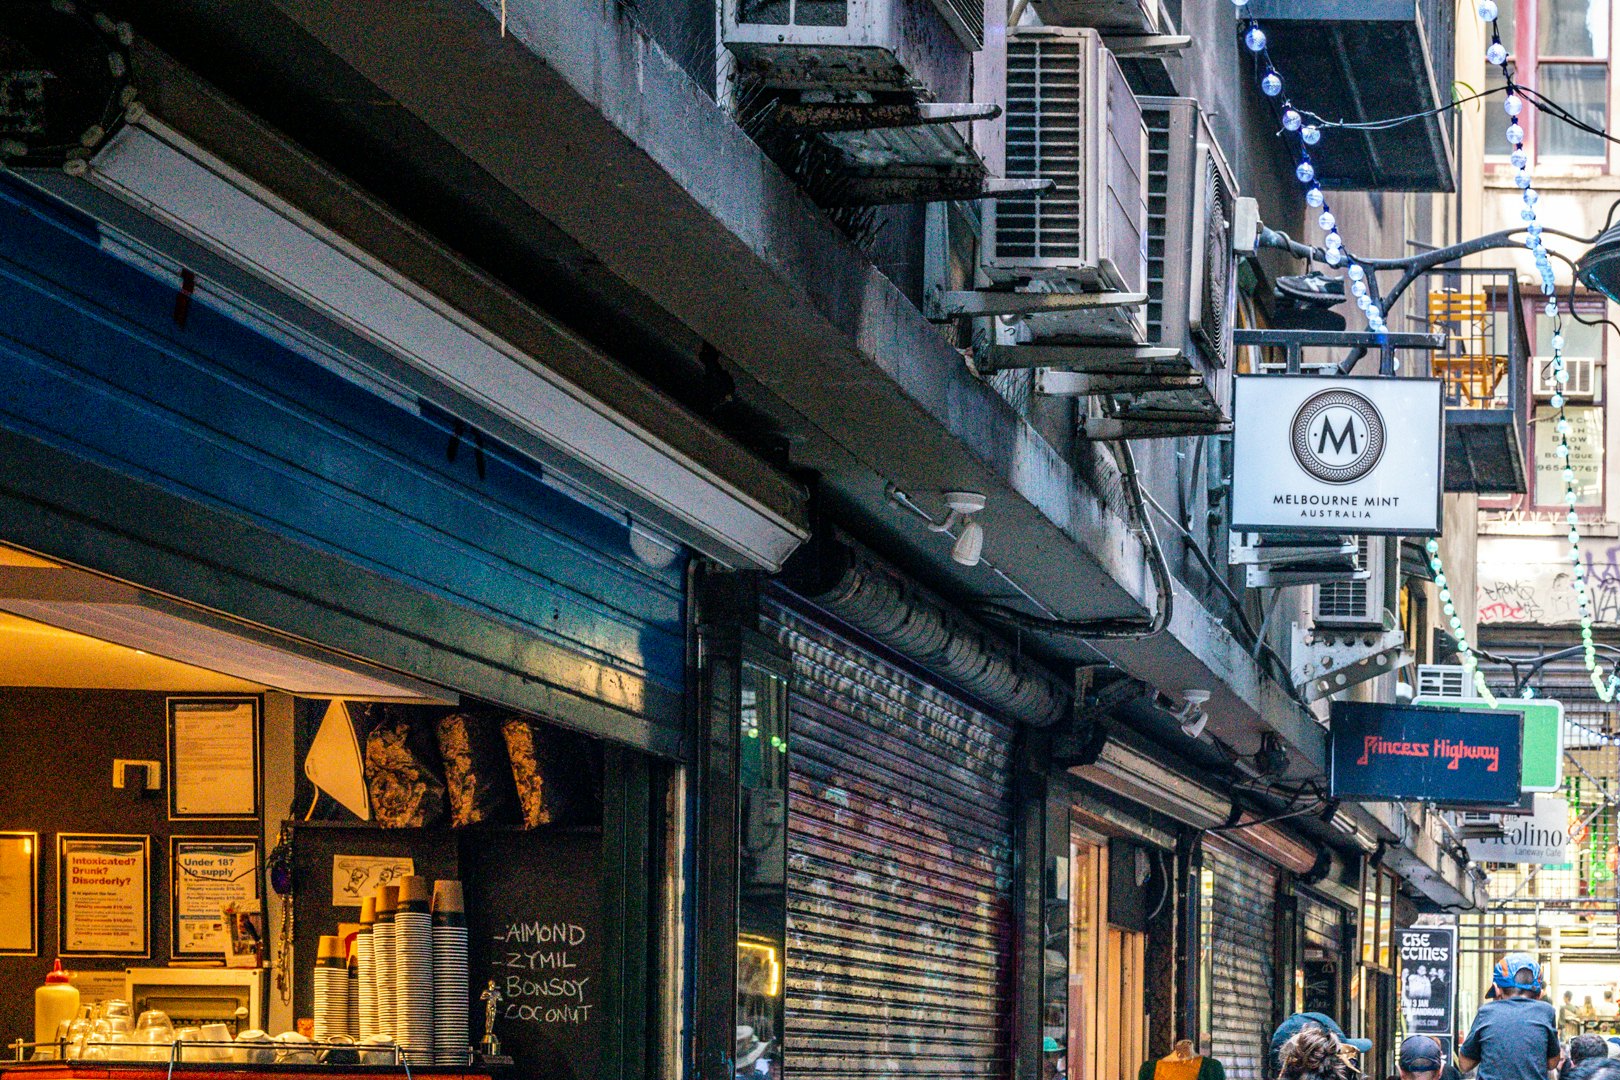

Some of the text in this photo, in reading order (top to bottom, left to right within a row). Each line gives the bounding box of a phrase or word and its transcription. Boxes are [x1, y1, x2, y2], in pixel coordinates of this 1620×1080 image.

[1273, 494, 1400, 508] MELBOURNE MINT
[1300, 509, 1371, 519] AUSTRALIA
[1356, 735, 1500, 772] Princess Highway
[72, 857, 137, 866] Intoxicated?
[184, 858, 235, 866] Under 18?
[72, 866, 109, 875] Drunk?
[72, 876, 132, 887] Disorderly?
[1402, 933, 1431, 947] THE
[506, 950, 577, 969] ZYMIL
[506, 975, 590, 1003] BONSOY
[504, 1004, 593, 1024] COCONUT
